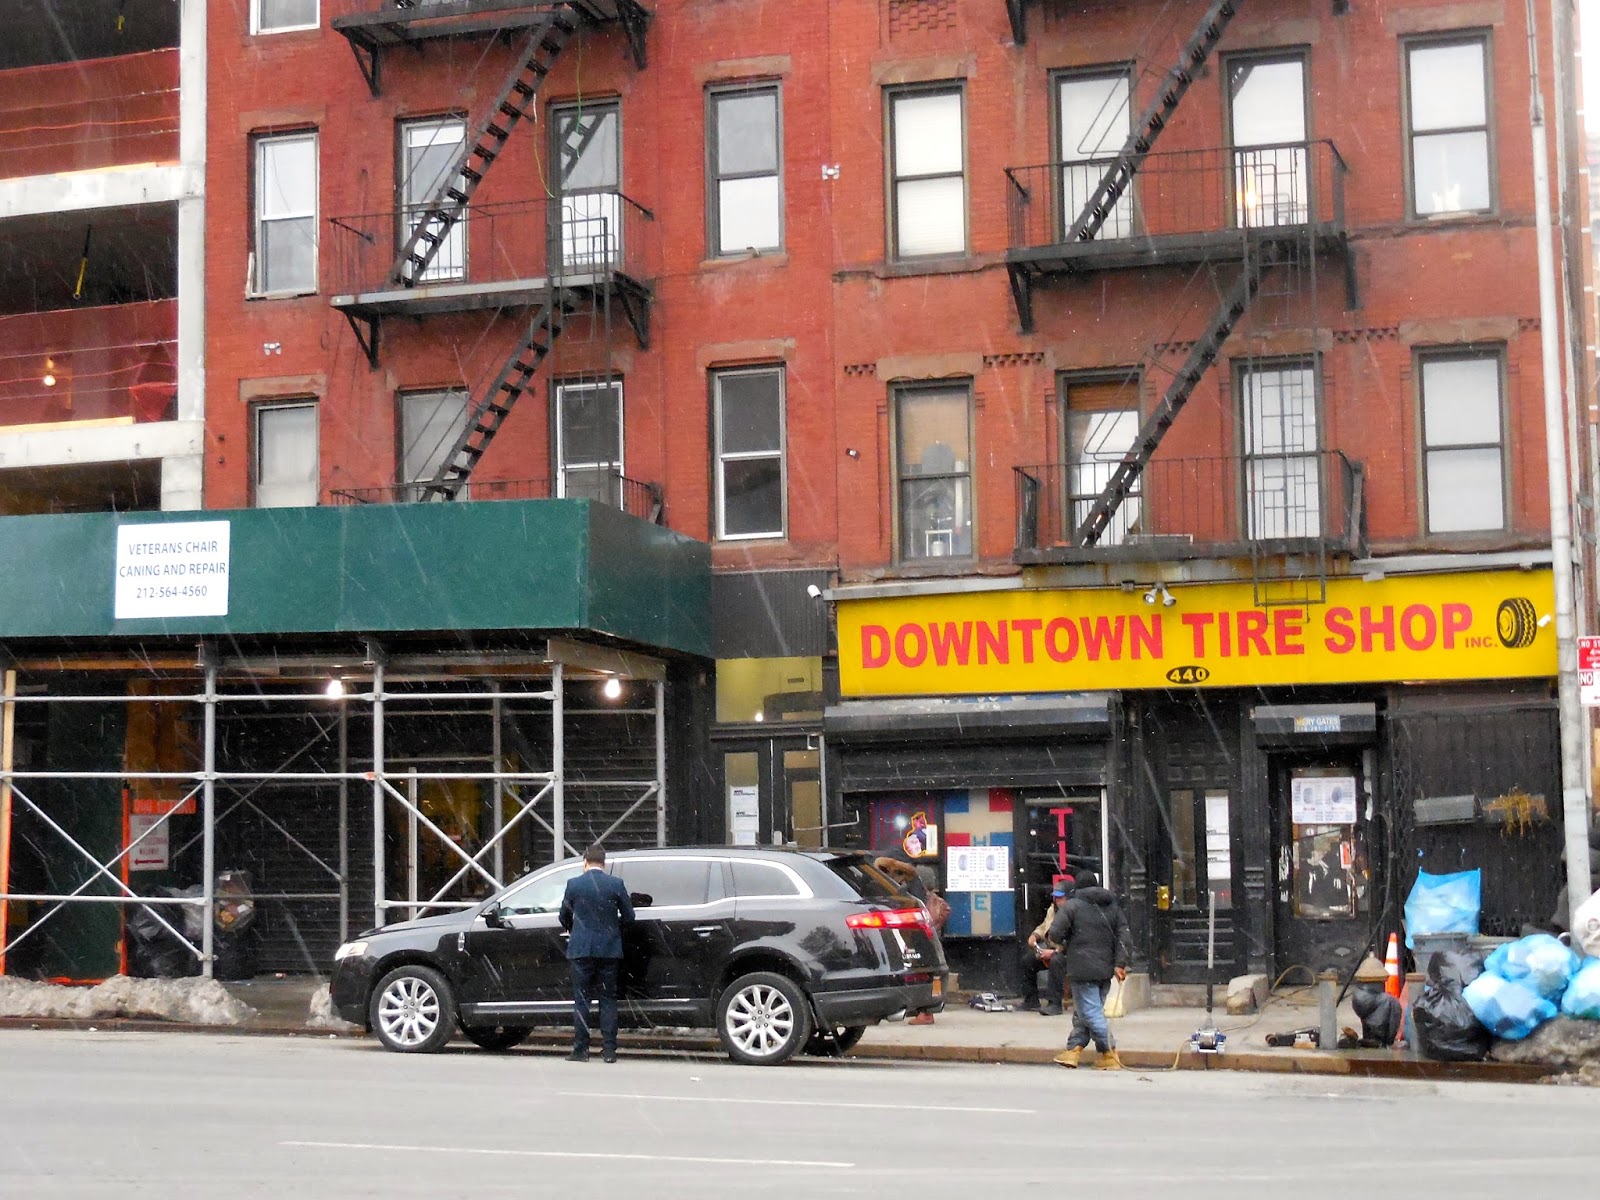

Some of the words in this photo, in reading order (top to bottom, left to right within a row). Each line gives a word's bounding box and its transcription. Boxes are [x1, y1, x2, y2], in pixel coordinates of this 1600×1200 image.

[129, 543, 183, 555] VETERANS
[186, 541, 218, 553] CHAIR
[120, 565, 160, 577] CANING
[163, 563, 186, 575] AND
[189, 562, 226, 574] REPAIR
[136, 585, 208, 598] 212-564-4560
[860, 613, 1164, 669] DOWNTOWN
[1181, 608, 1305, 659] TIRE
[1324, 603, 1473, 654] SHOP
[1465, 636, 1498, 648] INC.
[1170, 668, 1206, 682] 440
[1580, 672, 1593, 685] NO
